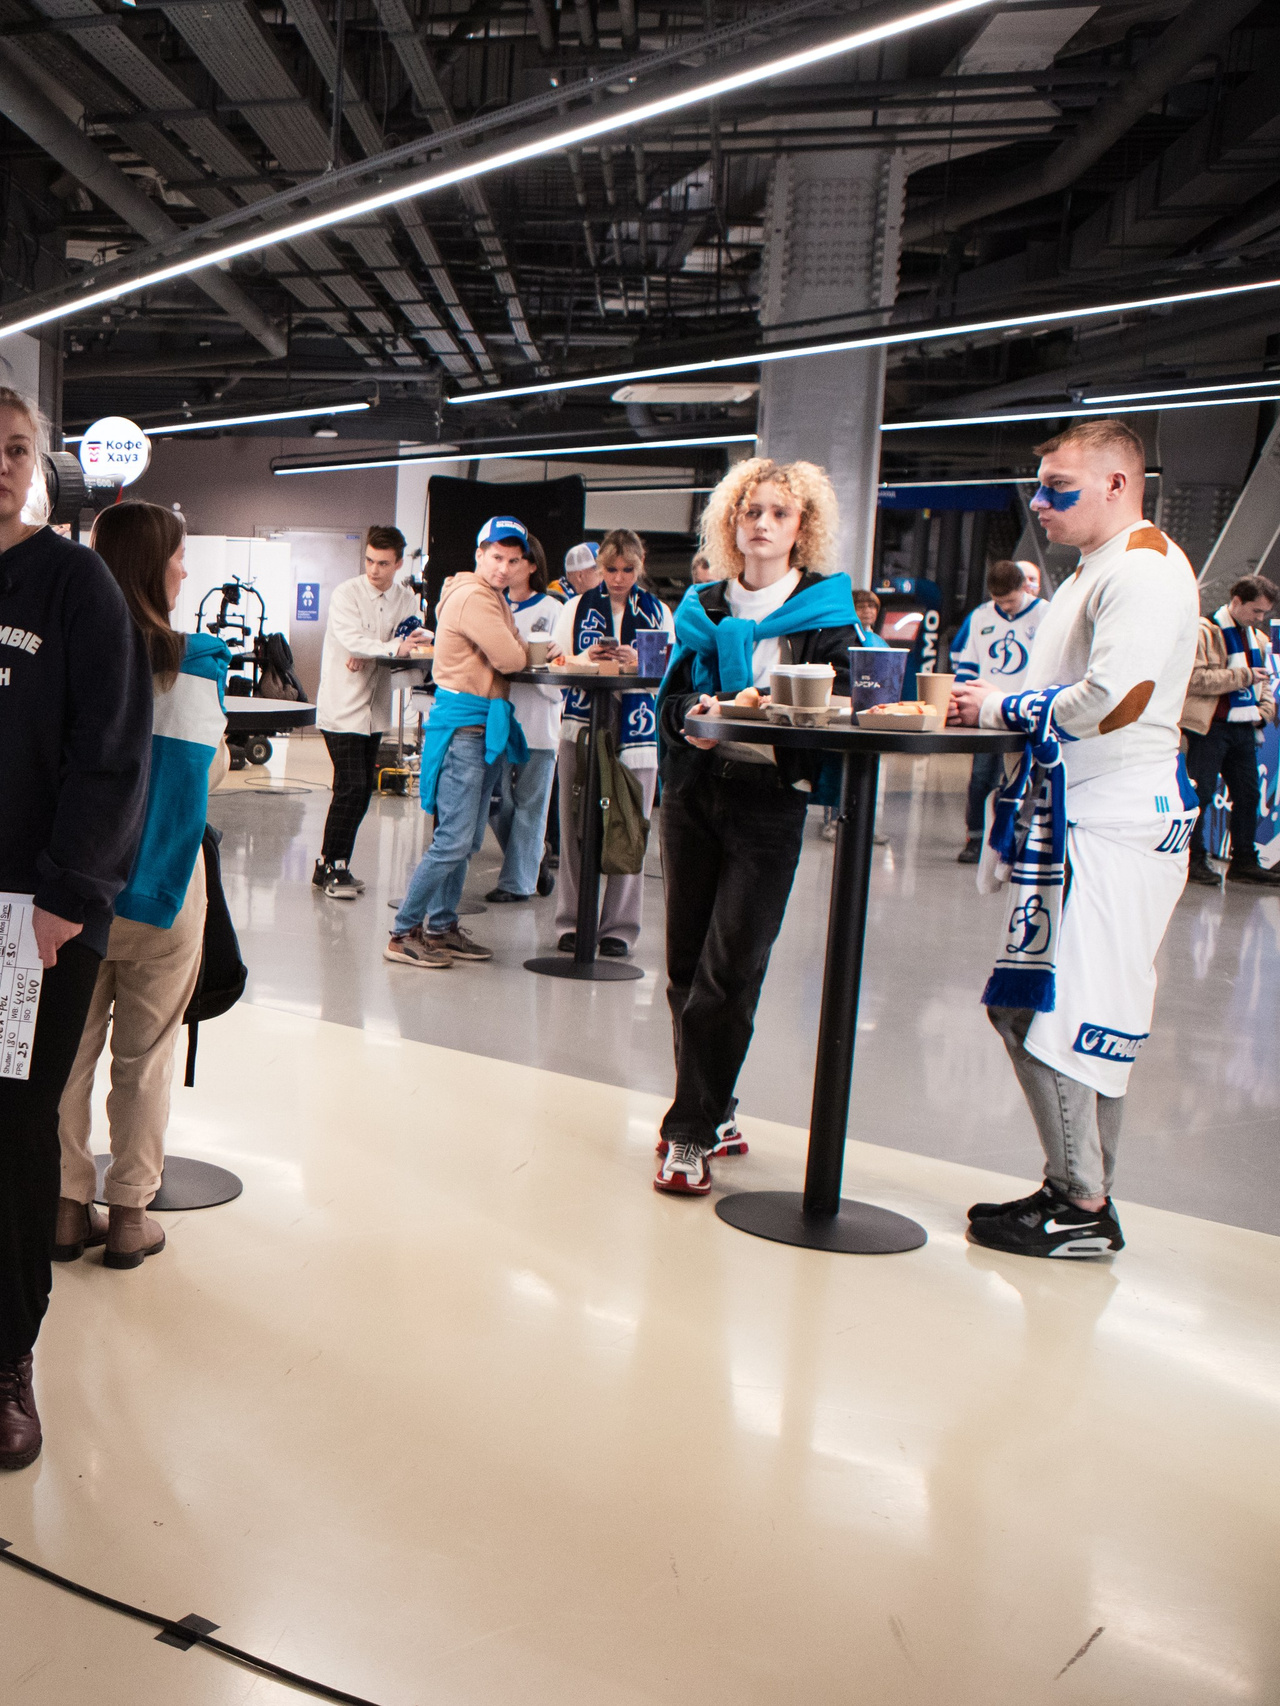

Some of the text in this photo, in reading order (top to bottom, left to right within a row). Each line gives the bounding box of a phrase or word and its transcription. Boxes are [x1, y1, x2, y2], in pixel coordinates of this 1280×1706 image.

[106, 440, 142, 451] Кофе
[107, 453, 139, 464] Хауз
[0, 905, 9, 919] Sync
[13, 973, 24, 1005] 4400
[26, 980, 39, 1003] 800
[6, 1031, 16, 1048] 180
[17, 1041, 29, 1059] 25
[3, 1051, 12, 1074] Shutter:
[16, 1061, 24, 1076] FPS:
